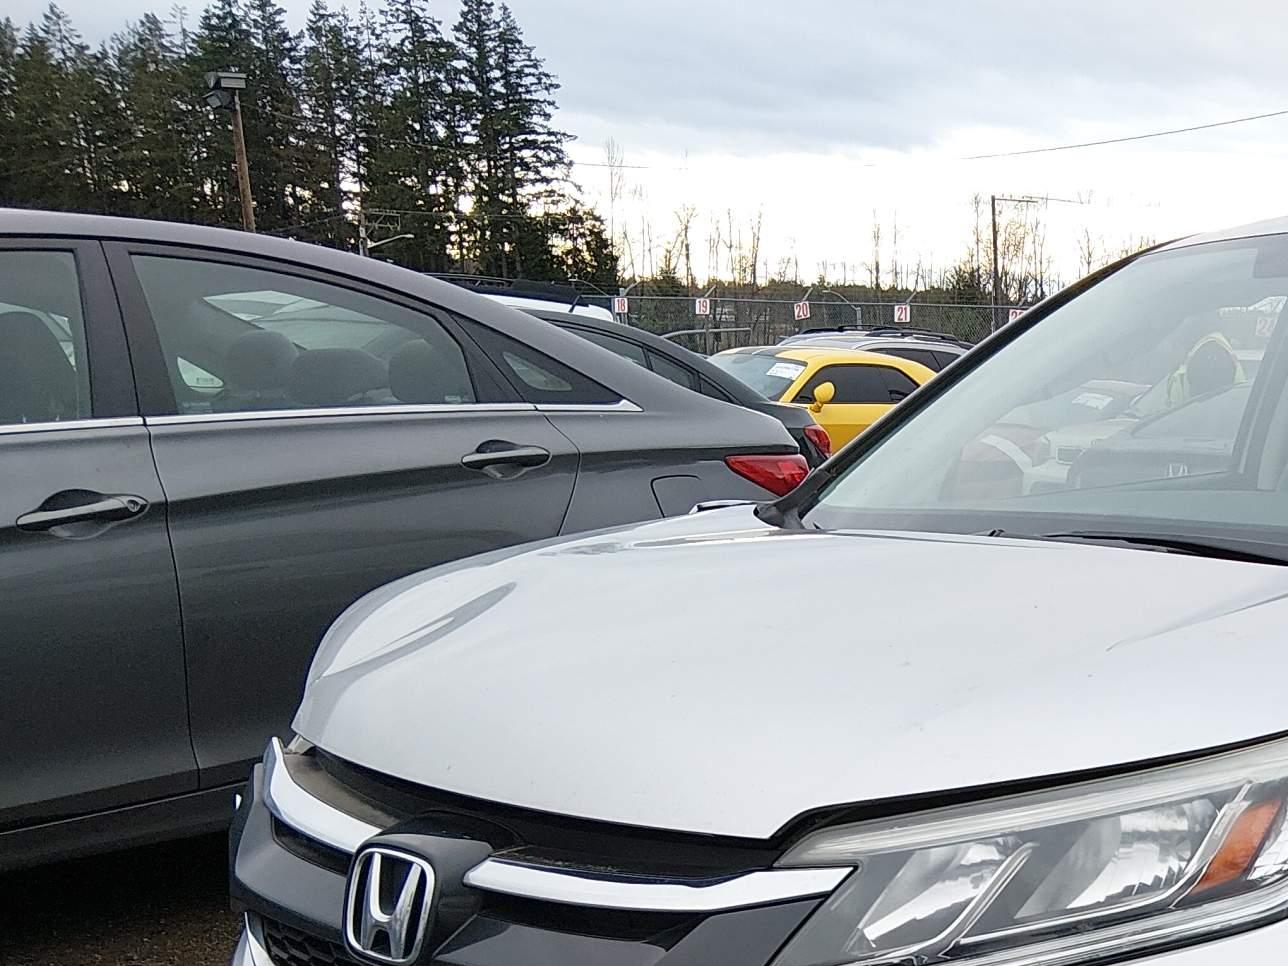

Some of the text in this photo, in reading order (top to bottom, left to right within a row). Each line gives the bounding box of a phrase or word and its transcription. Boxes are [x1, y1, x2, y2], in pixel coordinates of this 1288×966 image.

[616, 298, 626, 311] 18
[697, 299, 708, 313] 19
[795, 302, 808, 318] 20
[897, 306, 907, 321] 21
